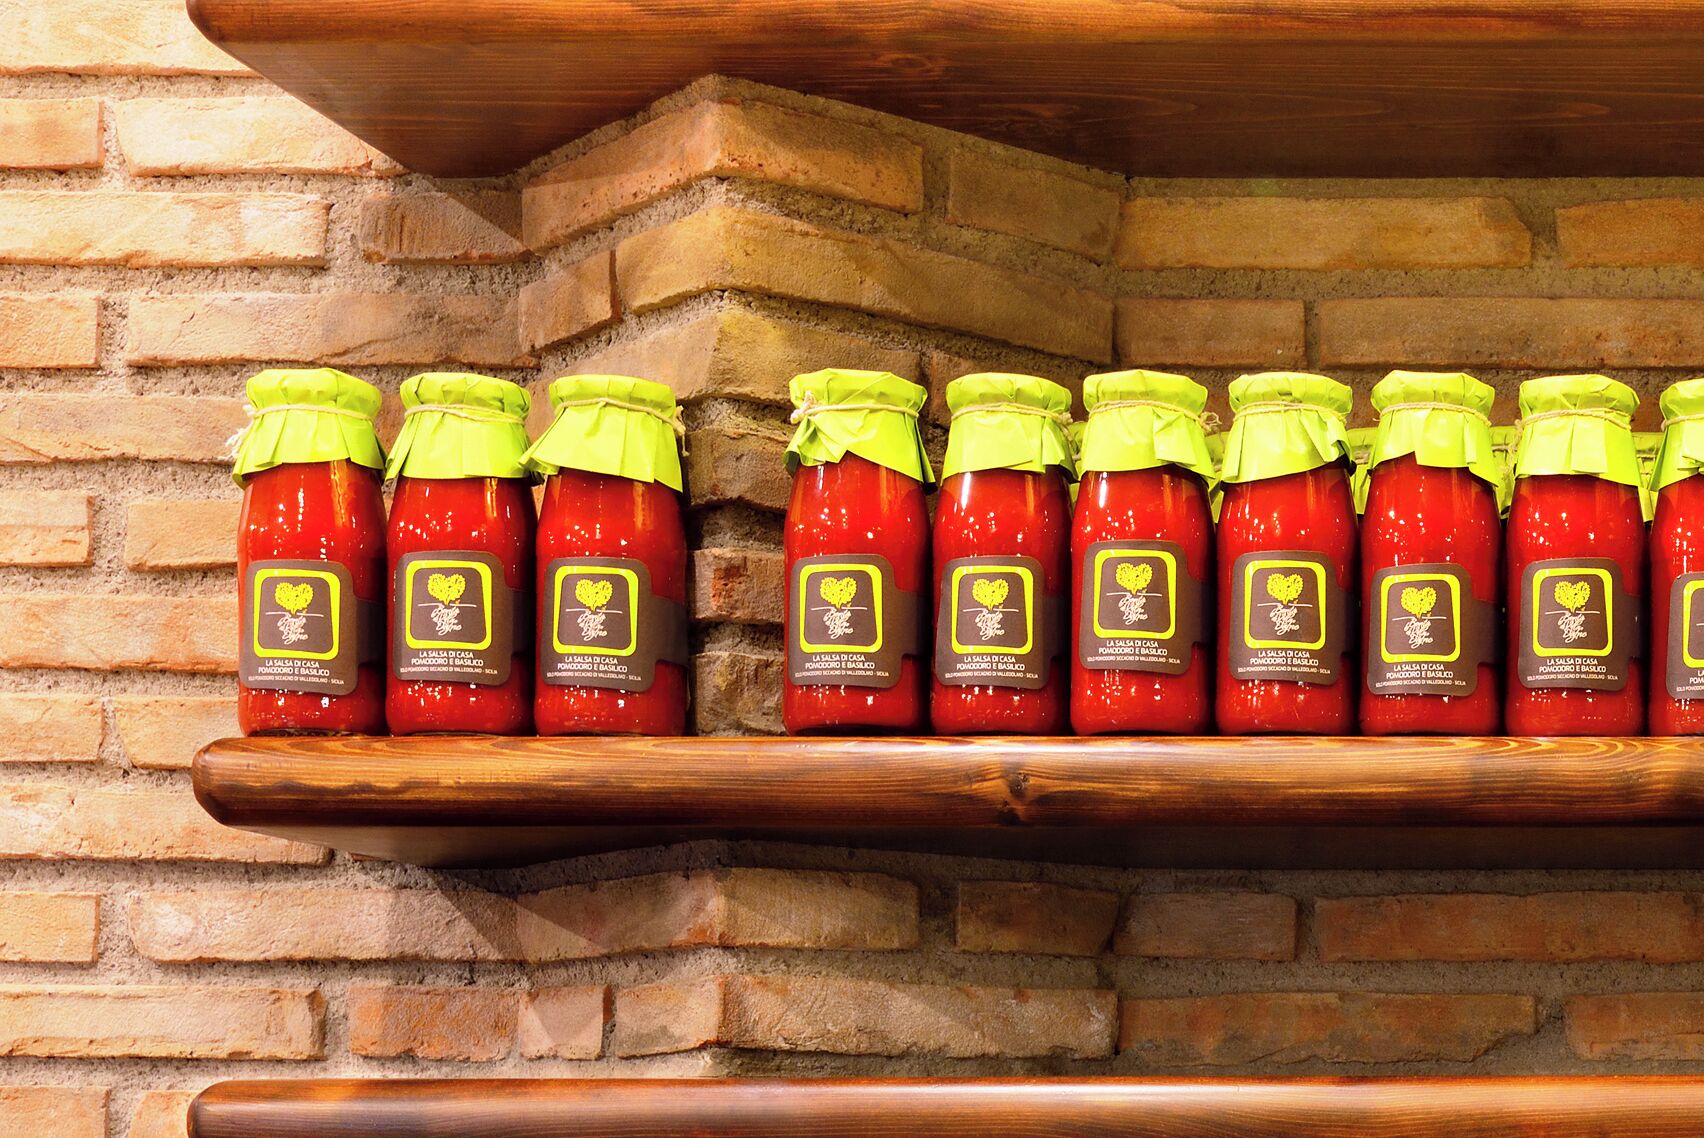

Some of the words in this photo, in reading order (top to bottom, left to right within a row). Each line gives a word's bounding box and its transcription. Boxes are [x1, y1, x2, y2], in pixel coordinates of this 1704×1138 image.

[1099, 647, 1134, 655] POMODORO
[1141, 648, 1168, 656] BASILICO
[574, 656, 592, 664] SALSA
[601, 657, 618, 665] CASA
[599, 664, 628, 673] BASILICO
[805, 662, 841, 670] POMODORO
[258, 667, 294, 675] POMODORO
[300, 668, 330, 677] BASILICO
[1386, 671, 1421, 680] POMODORO
